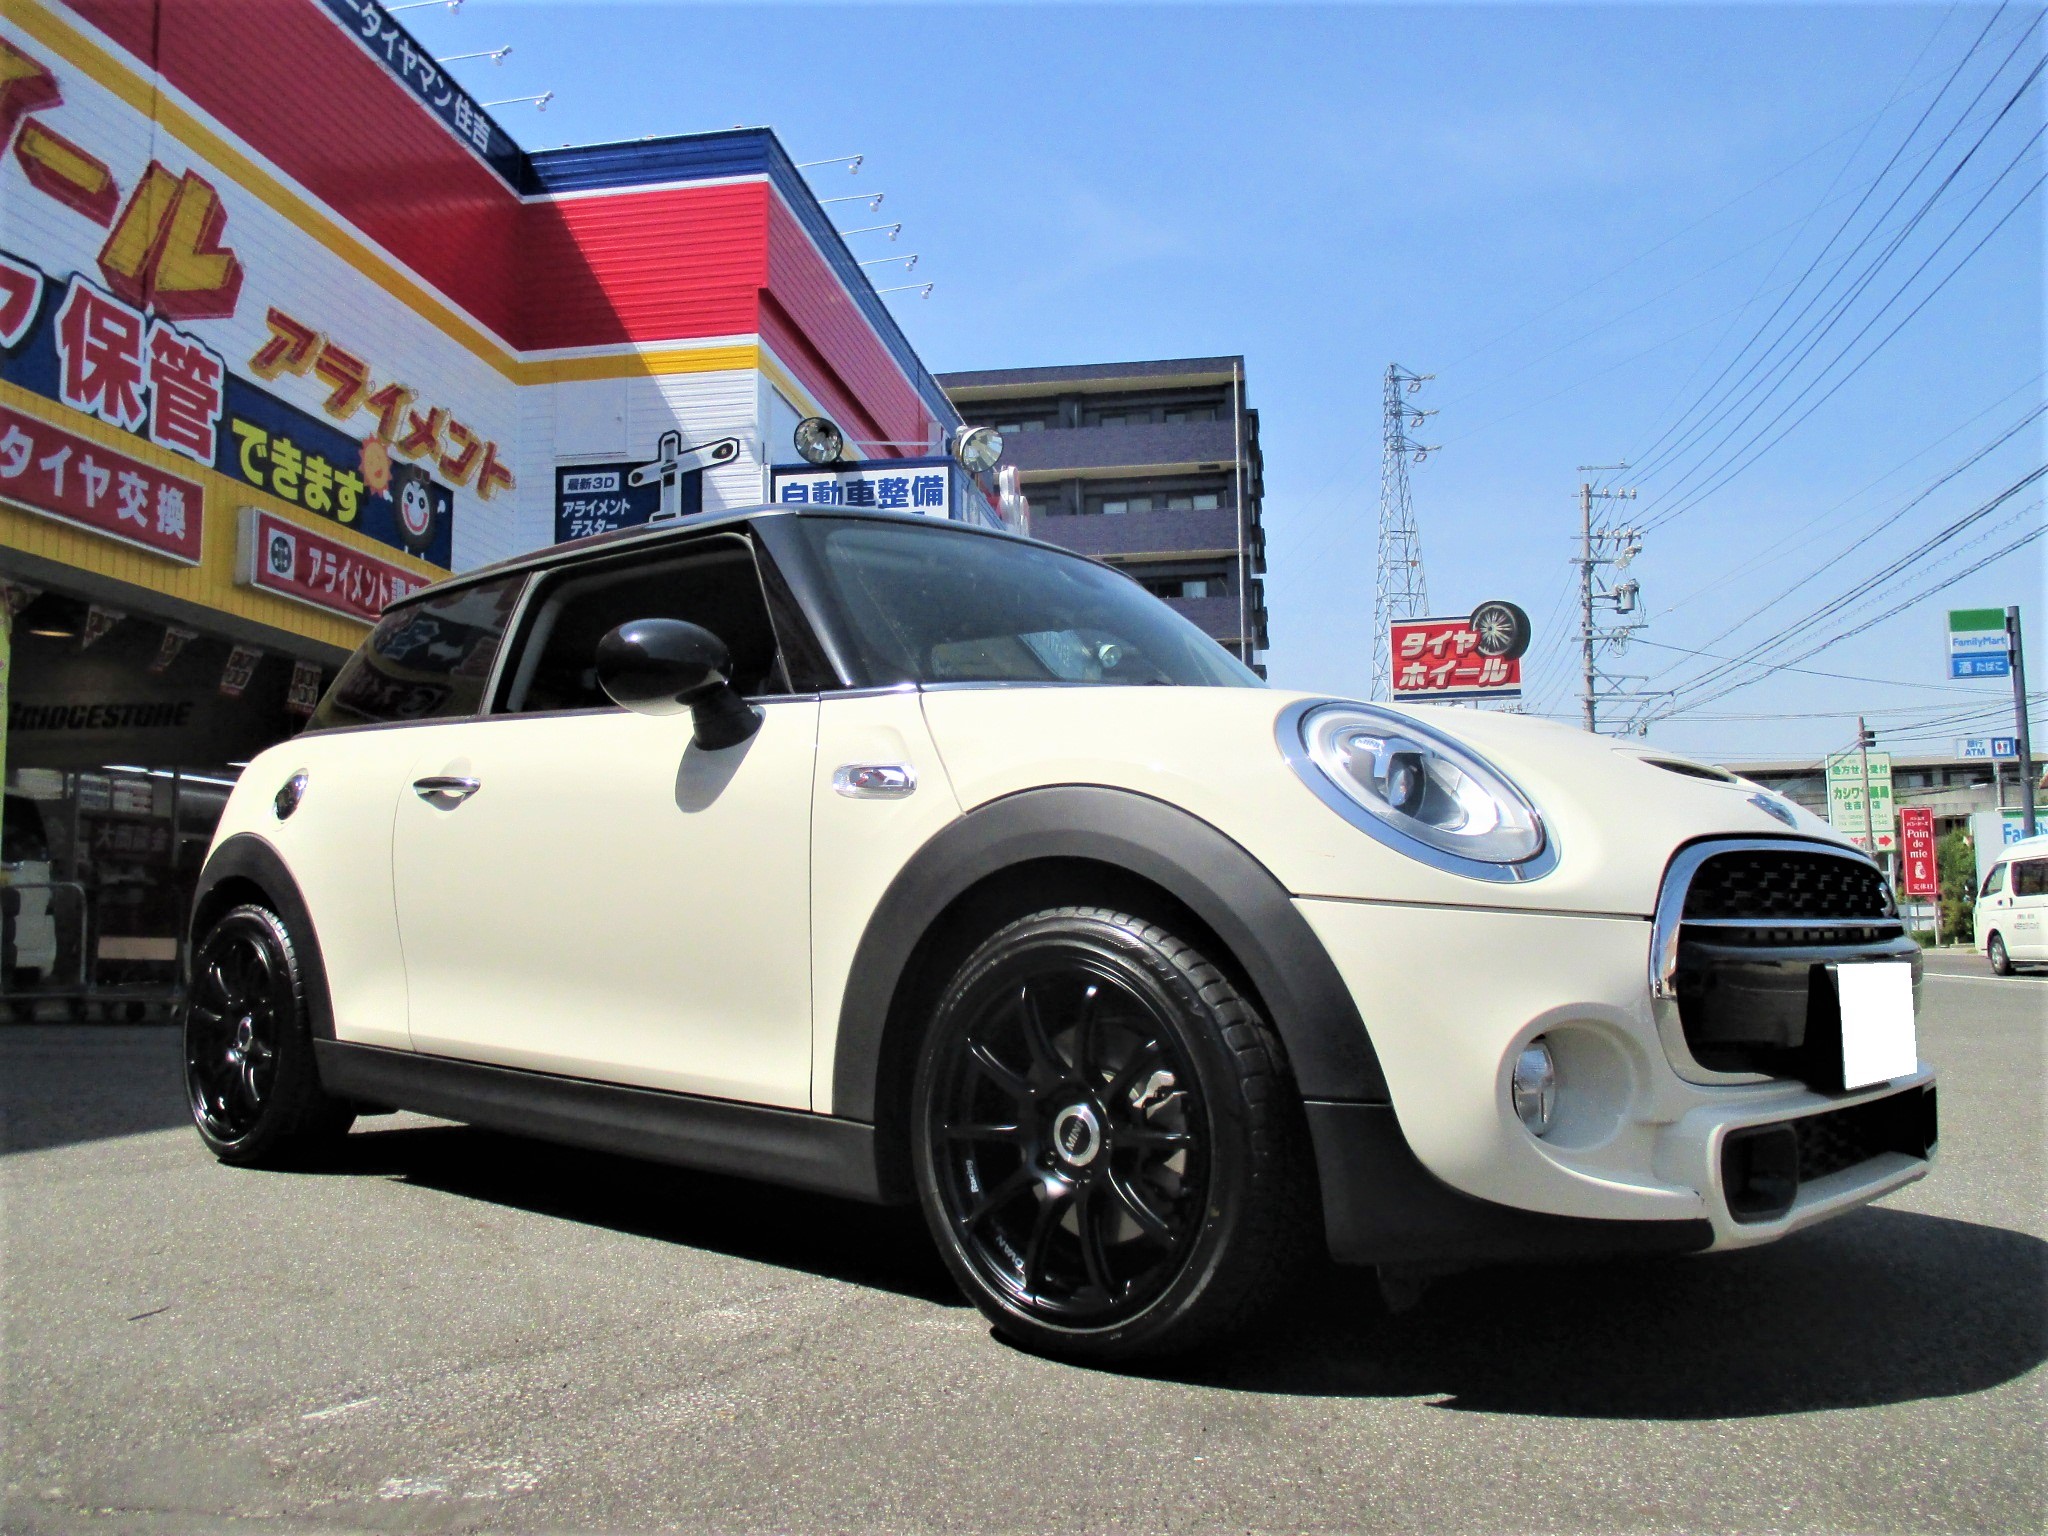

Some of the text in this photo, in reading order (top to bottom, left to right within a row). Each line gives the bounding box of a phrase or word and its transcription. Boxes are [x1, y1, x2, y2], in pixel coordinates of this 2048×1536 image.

[455, 94, 491, 153] 住吉
[0, 36, 244, 322] ール
[248, 306, 516, 502] アライメント
[231, 417, 364, 523] できます
[0, 424, 186, 541] タイヤ交換
[782, 475, 944, 510] 自動車整備
[562, 498, 631, 518] アライメント
[571, 519, 618, 536] テスター
[1401, 630, 1478, 657] タイヤ
[1952, 636, 2006, 648] FamilyMart
[1399, 658, 1508, 687] ホイール
[1965, 748, 1986, 757] ATM
[1832, 765, 1888, 775] 処方せ受付
[1907, 829, 1929, 838] Pain
[1912, 839, 1924, 848] de
[1910, 850, 1928, 859] mie
